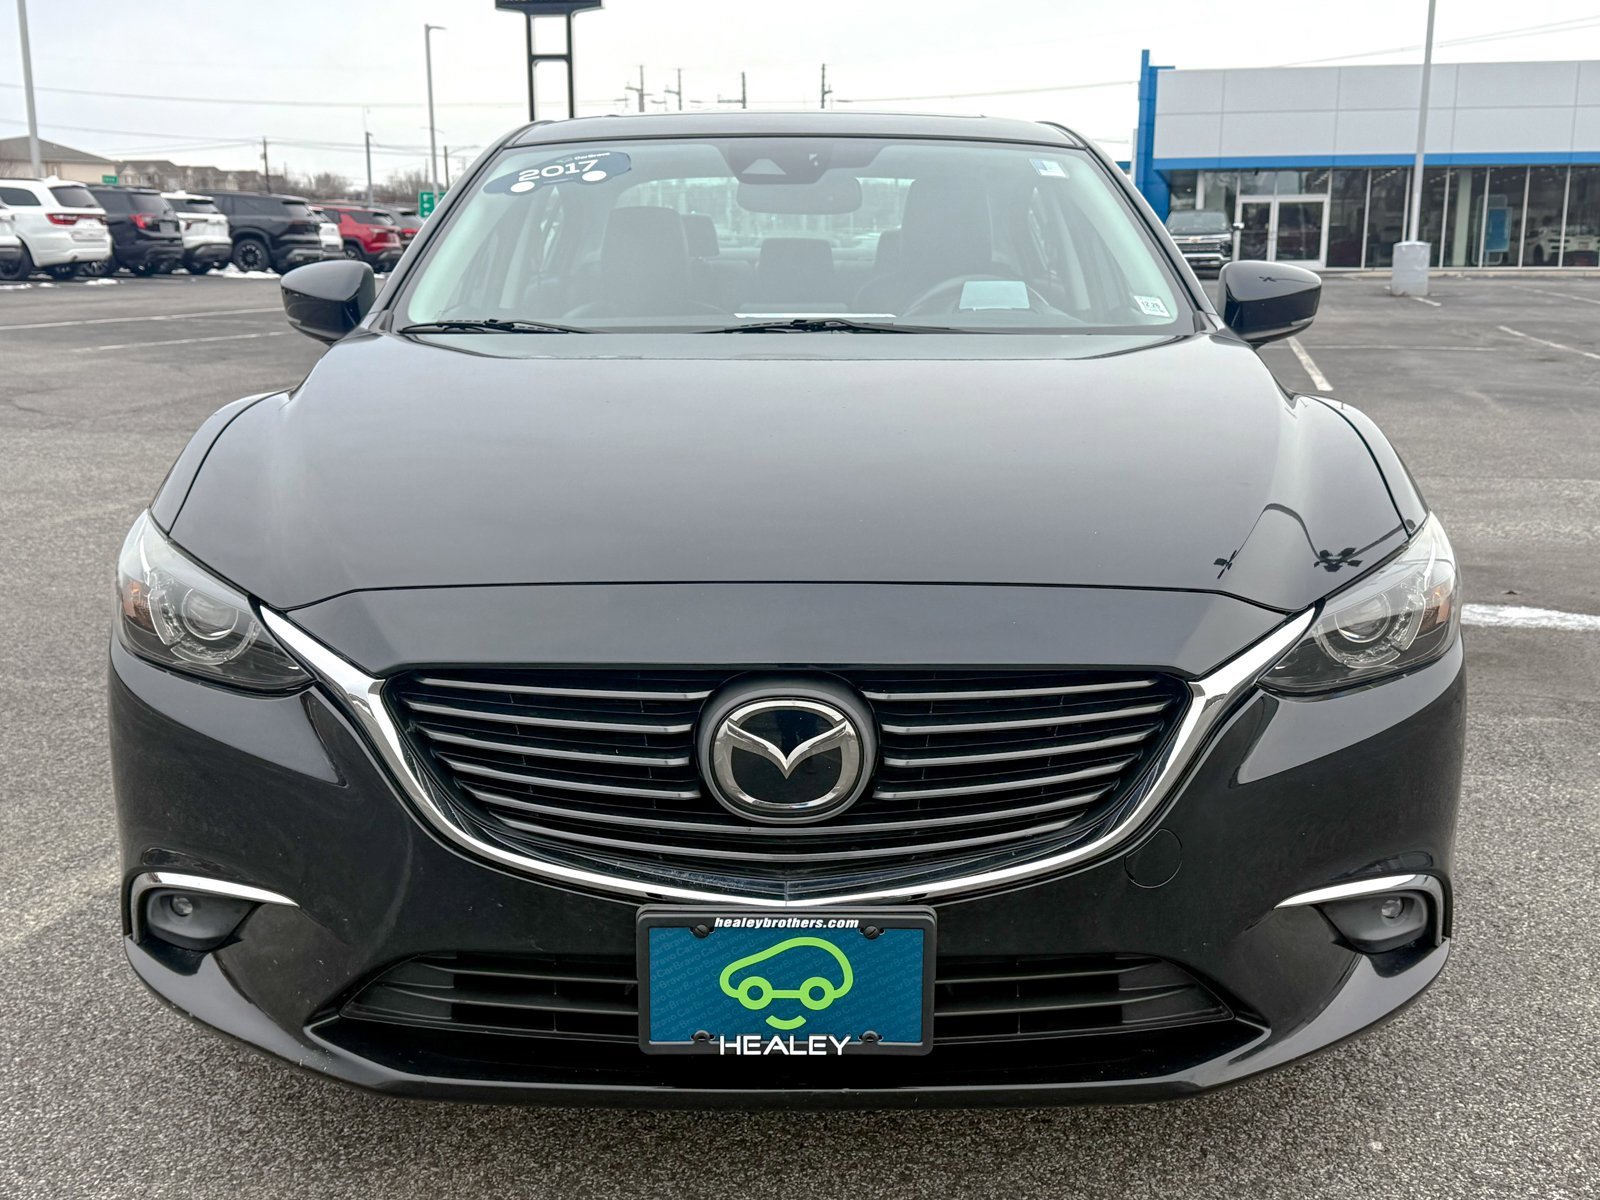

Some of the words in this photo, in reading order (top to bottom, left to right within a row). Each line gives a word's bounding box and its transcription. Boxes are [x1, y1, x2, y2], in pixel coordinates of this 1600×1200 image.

[519, 159, 599, 181] 2017
[714, 917, 859, 930] healeybrothers.com
[719, 1034, 851, 1056] HEALEY
